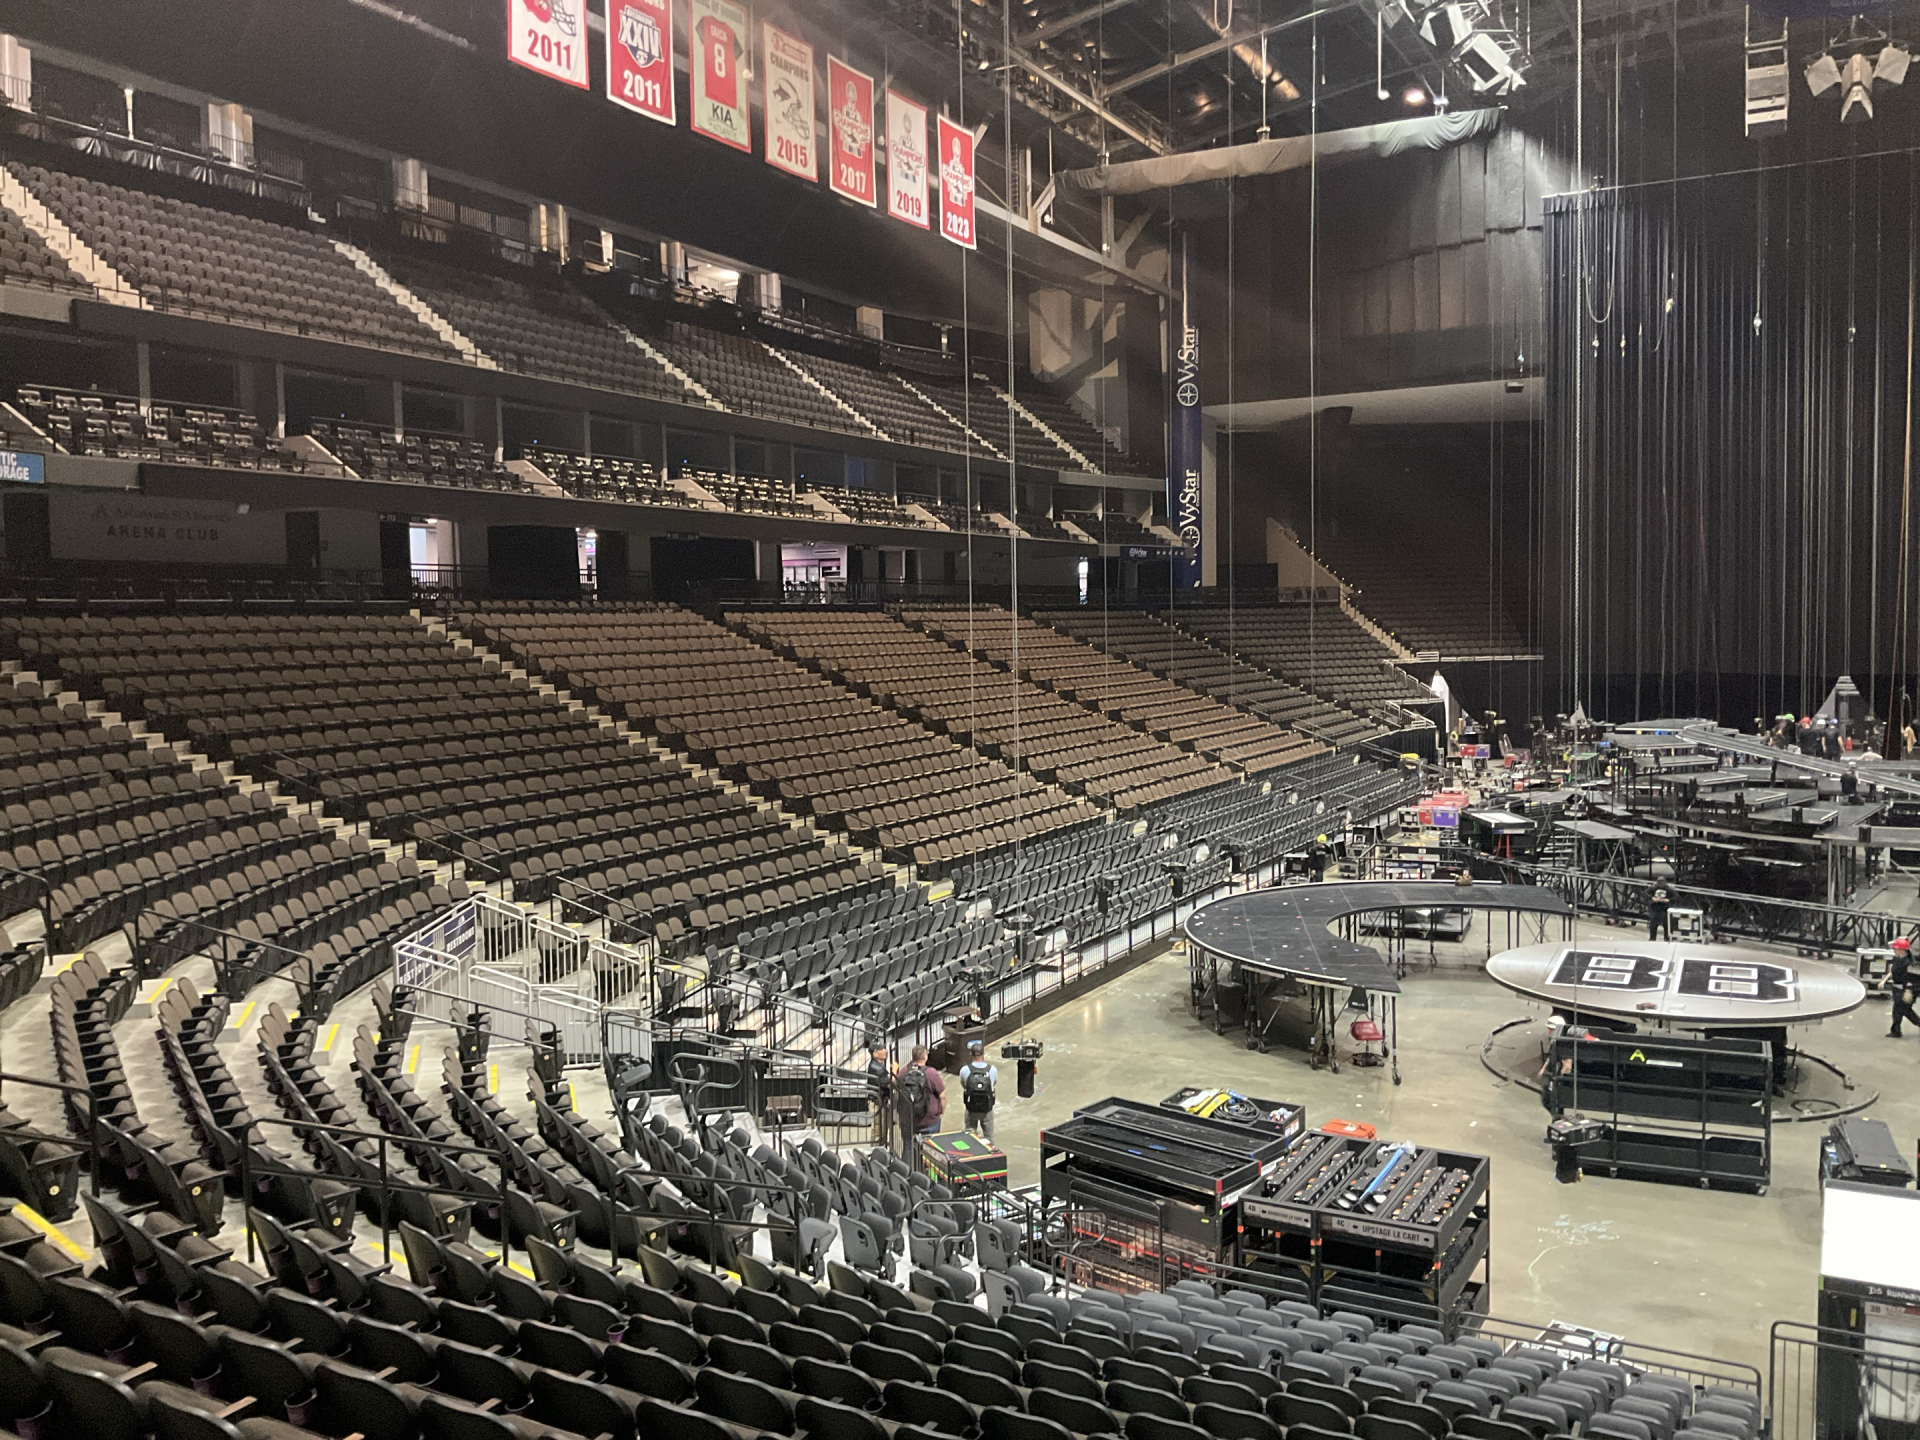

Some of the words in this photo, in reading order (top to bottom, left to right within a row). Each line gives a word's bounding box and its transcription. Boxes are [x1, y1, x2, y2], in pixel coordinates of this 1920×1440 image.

[528, 28, 571, 70] 2011
[619, 14, 661, 58] XXIV
[714, 43, 726, 78] 8
[623, 70, 661, 109] 2011
[712, 103, 734, 129] KIA
[777, 135, 808, 168] 2015
[841, 164, 866, 194] 2017
[896, 190, 921, 217] 2019
[947, 212, 970, 239] 2023
[1178, 325, 1198, 384] VyStar
[1179, 469, 1200, 527] VyStar
[107, 525, 166, 539] ARENA
[175, 528, 219, 541] CLUB
[446, 926, 475, 953] RESTROOMS
[1630, 1049, 1645, 1062] A
[1248, 1204, 1256, 1212] 4B
[1336, 1218, 1345, 1227] 4C
[1362, 1225, 1391, 1237] UPSTAGE
[1393, 1230, 1401, 1239] LX
[1402, 1232, 1420, 1242] CART
